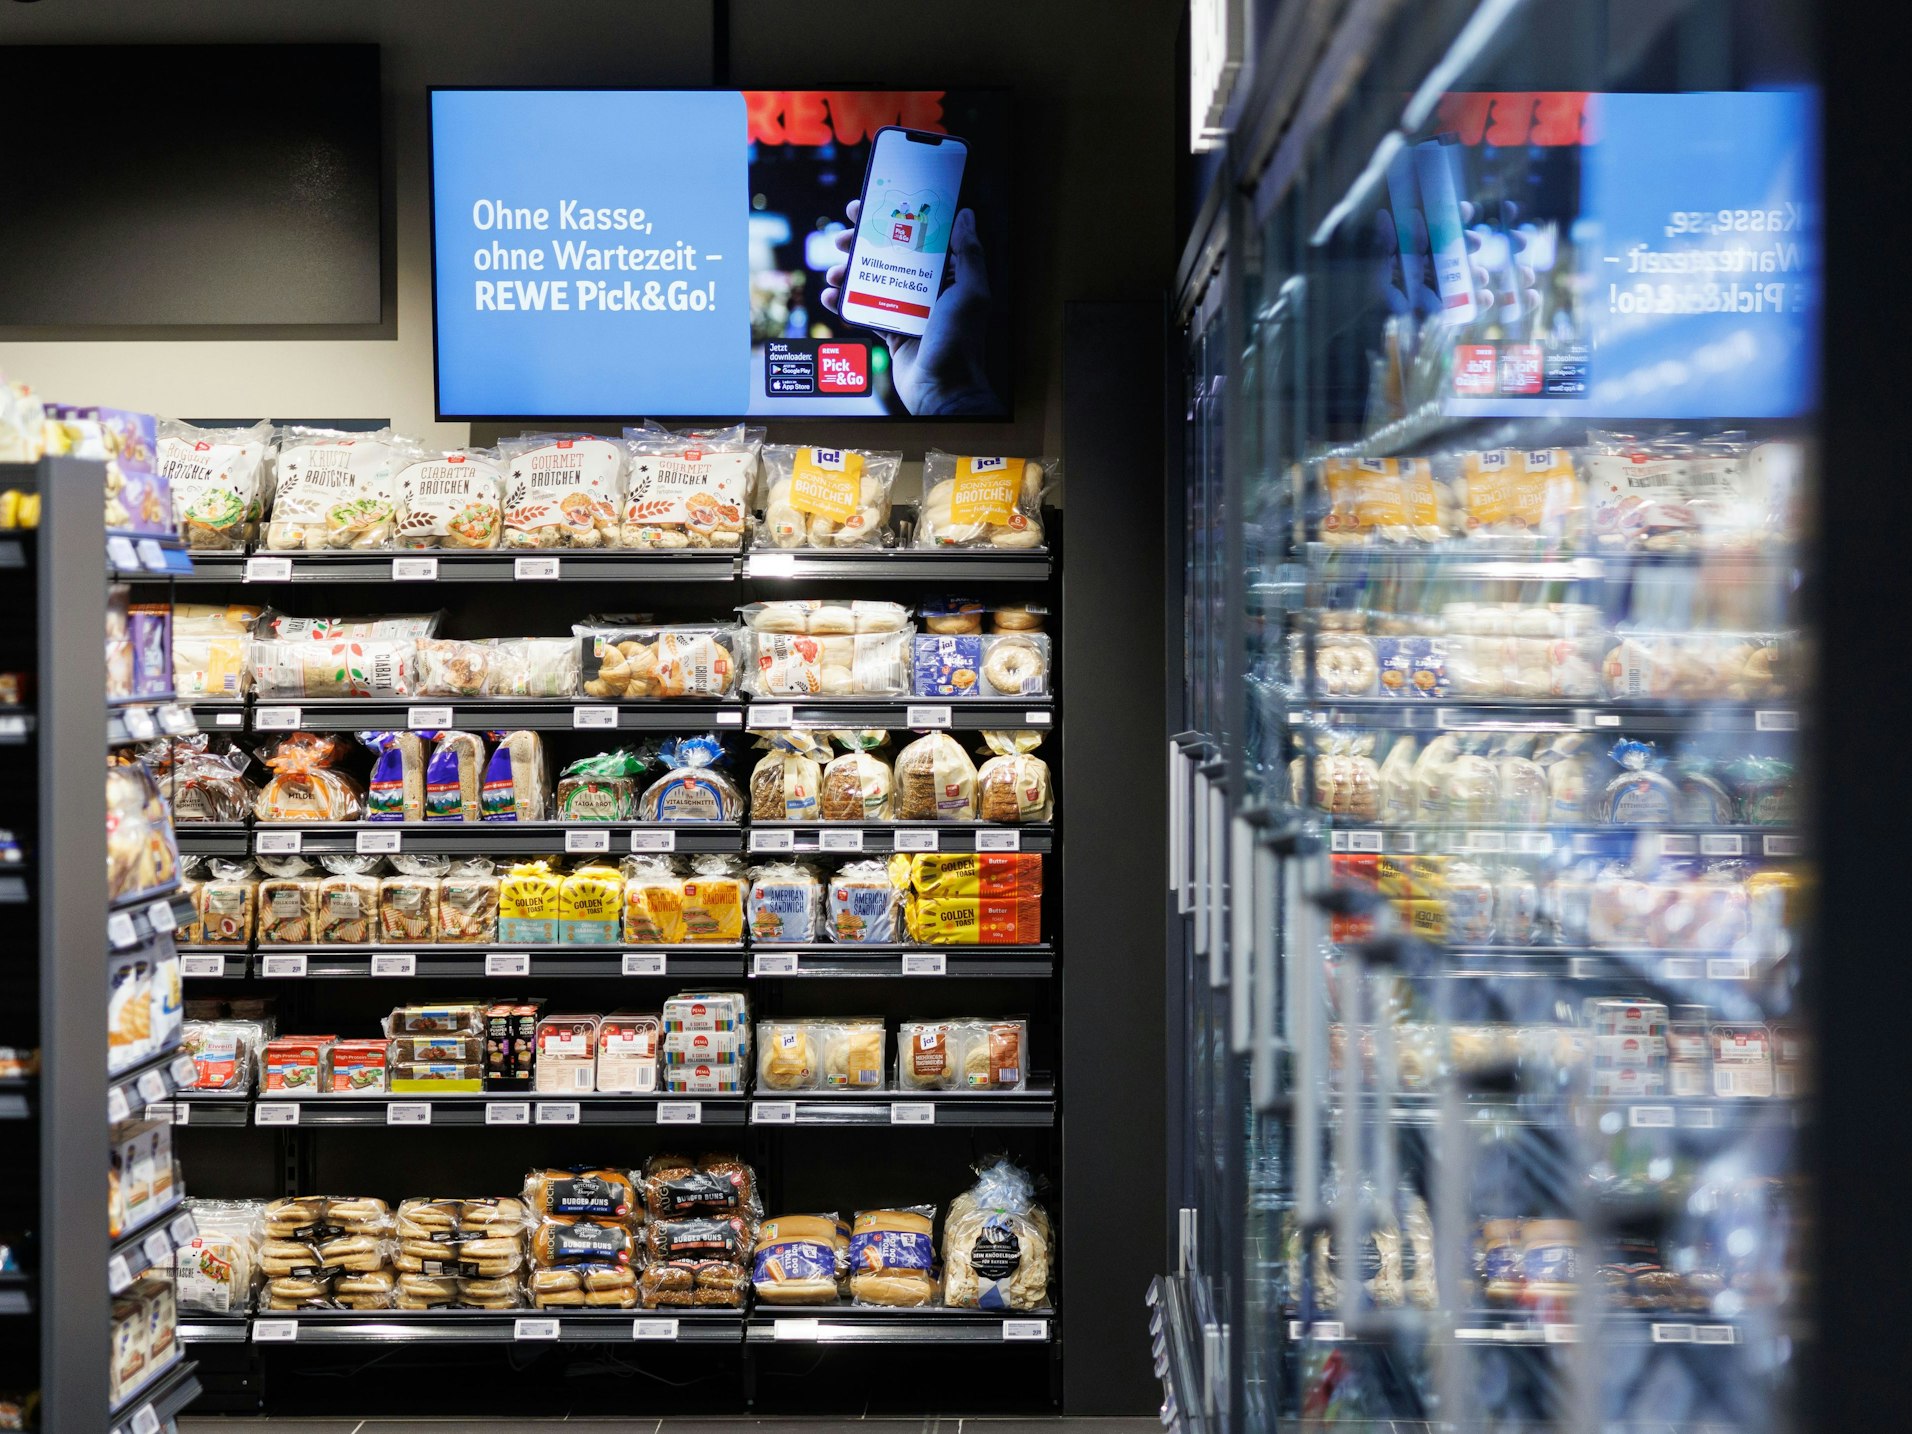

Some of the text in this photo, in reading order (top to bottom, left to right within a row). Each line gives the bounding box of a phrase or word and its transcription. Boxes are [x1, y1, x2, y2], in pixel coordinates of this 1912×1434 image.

[473, 199, 652, 235] Ohne Kasse,
[474, 240, 544, 270] ohne
[552, 240, 697, 270] Wartezeit
[861, 256, 934, 279] Willkommen bei
[859, 271, 928, 293] REWE Pick&Go
[475, 280, 716, 311] REWE Pick&Go!
[769, 343, 788, 352] Jetzt
[769, 353, 812, 361] downloaden:
[822, 358, 850, 371] Pick
[836, 372, 864, 385] &Go
[309, 449, 352, 468] KRUSTI
[531, 453, 584, 470] GOURMET
[817, 449, 840, 464] ja!
[977, 457, 1001, 469] ja!
[162, 460, 213, 481] BRÖTCHEN
[421, 467, 476, 480] CIABATTA
[659, 461, 711, 474] GOURMET
[531, 469, 581, 488] BRÖTCHEN
[657, 470, 708, 485] BRÖTCHEN
[419, 479, 470, 495] BRÖTCHEN
[960, 480, 1012, 491] SONNTAGS
[941, 641, 953, 650] ja!
[940, 859, 974, 873] GOLDEN
[955, 869, 975, 878] TOAST
[515, 897, 543, 907] GOLDEN
[702, 892, 737, 905] SANDWICH
[770, 890, 804, 901] AMERICAN
[854, 892, 888, 905] AMERICAN
[527, 905, 544, 913] TOAST
[574, 899, 603, 910] GOLDEN
[587, 907, 603, 915] TOAST
[769, 901, 804, 914] SANDWICH
[940, 908, 974, 922] GOLDEN
[955, 917, 975, 927] TOAST
[783, 1036, 795, 1046] ja!
[923, 1036, 934, 1046] ja!
[673, 1233, 722, 1243] BURGER BUNS
